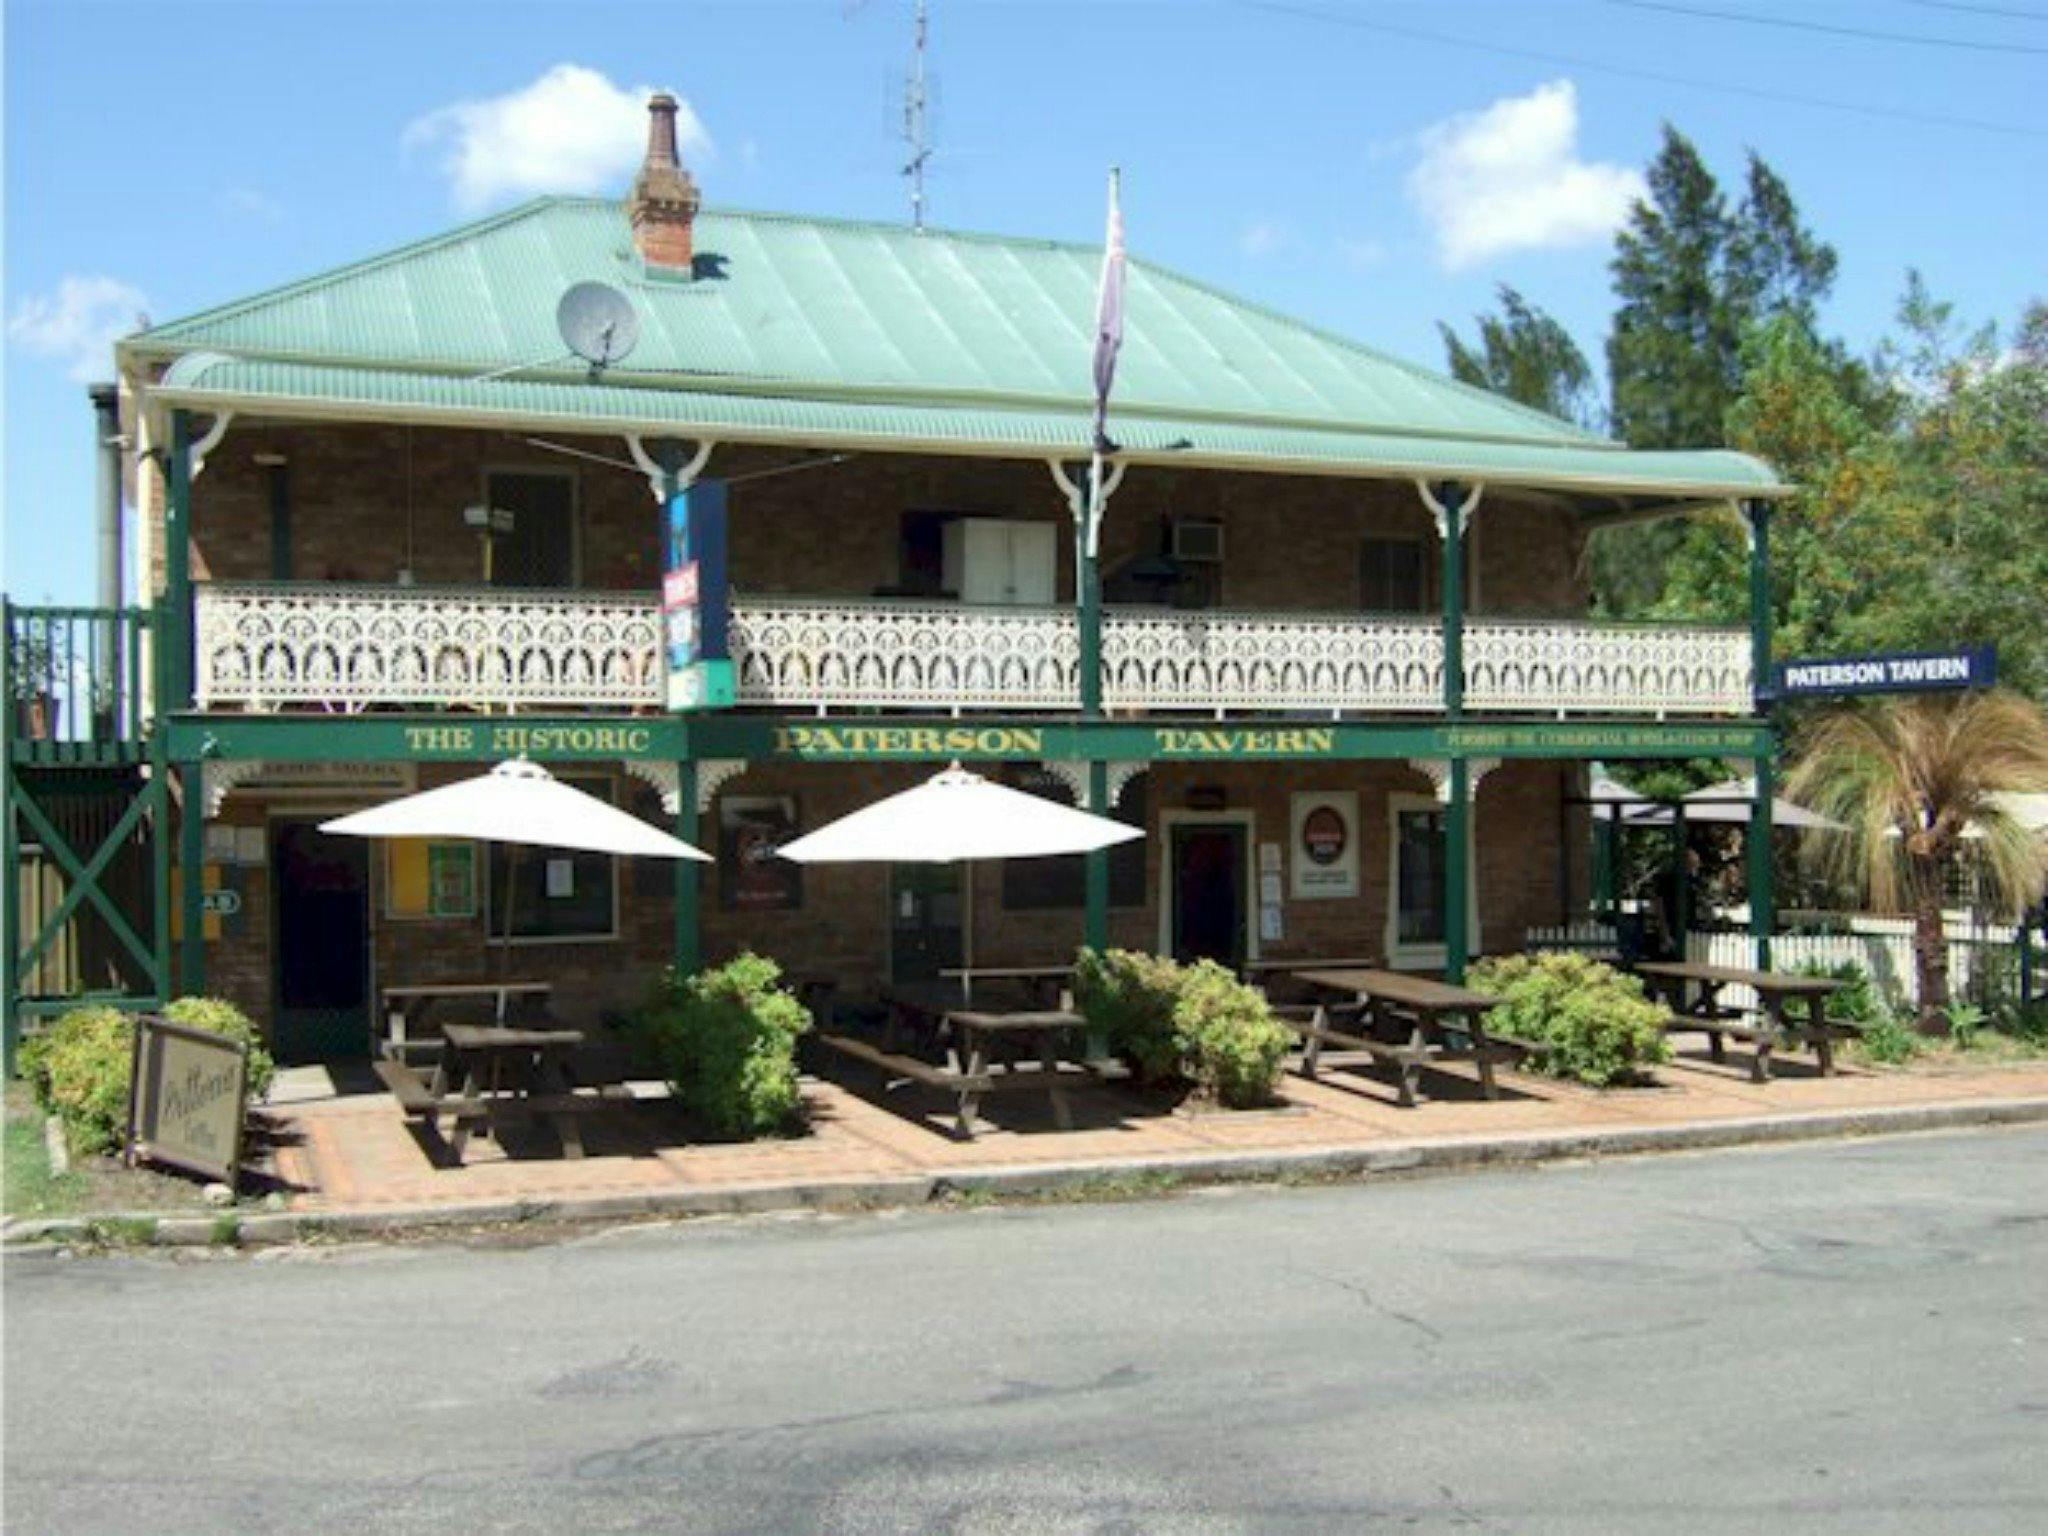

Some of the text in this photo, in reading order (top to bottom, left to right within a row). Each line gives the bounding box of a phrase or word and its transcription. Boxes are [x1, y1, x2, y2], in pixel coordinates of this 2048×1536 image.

[1785, 655, 1969, 687] PATERSON TAVERN
[405, 727, 1334, 752] THE HISTORIC PATERSON TAVERN
